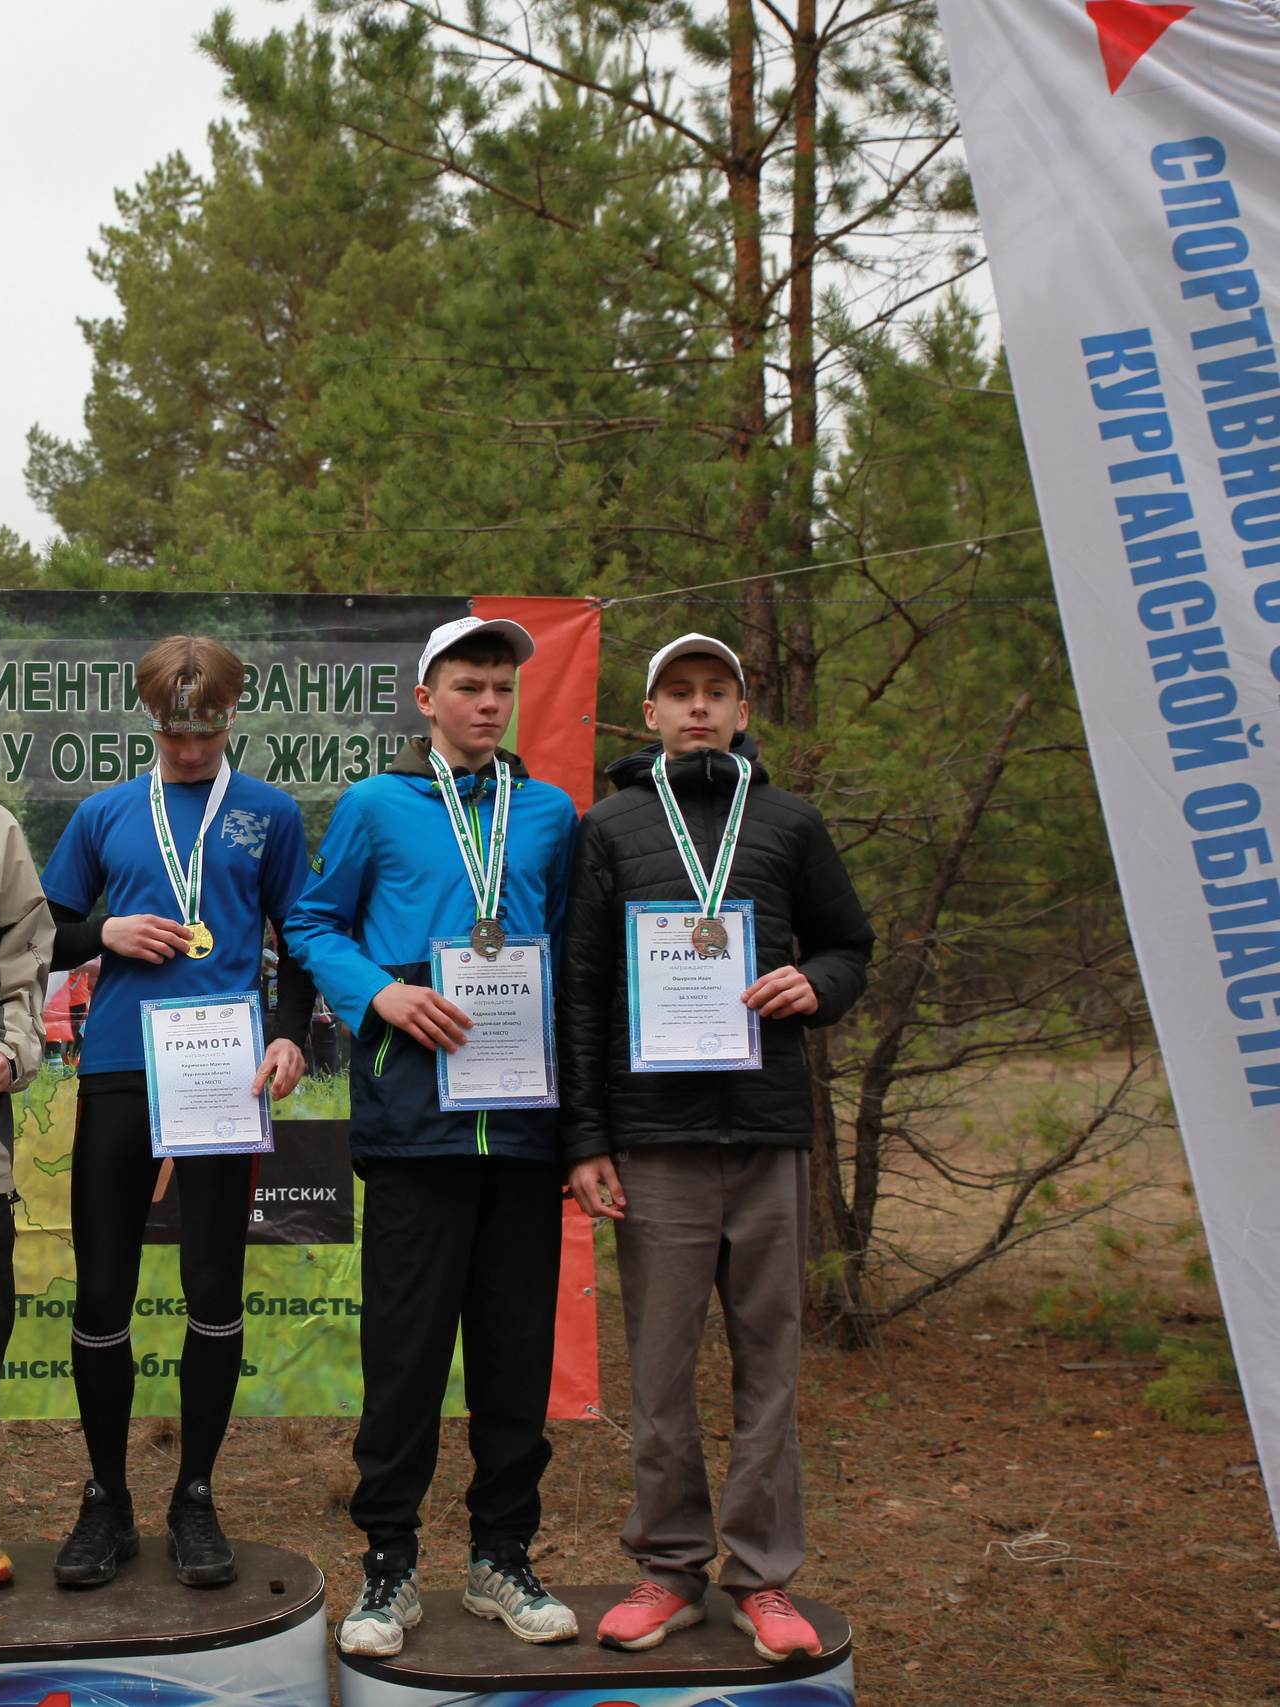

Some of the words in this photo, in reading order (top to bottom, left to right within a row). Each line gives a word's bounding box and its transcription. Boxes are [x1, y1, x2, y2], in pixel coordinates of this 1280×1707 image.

[1080, 328, 1265, 771] КУРГАНСКОЙ
[265, 734, 420, 784] ЖИЗН
[650, 950, 731, 961] ГРАМА
[455, 984, 530, 996] ГРАМОТА
[166, 1038, 241, 1051] ГРАМОТА
[242, 1291, 362, 1316] бласть
